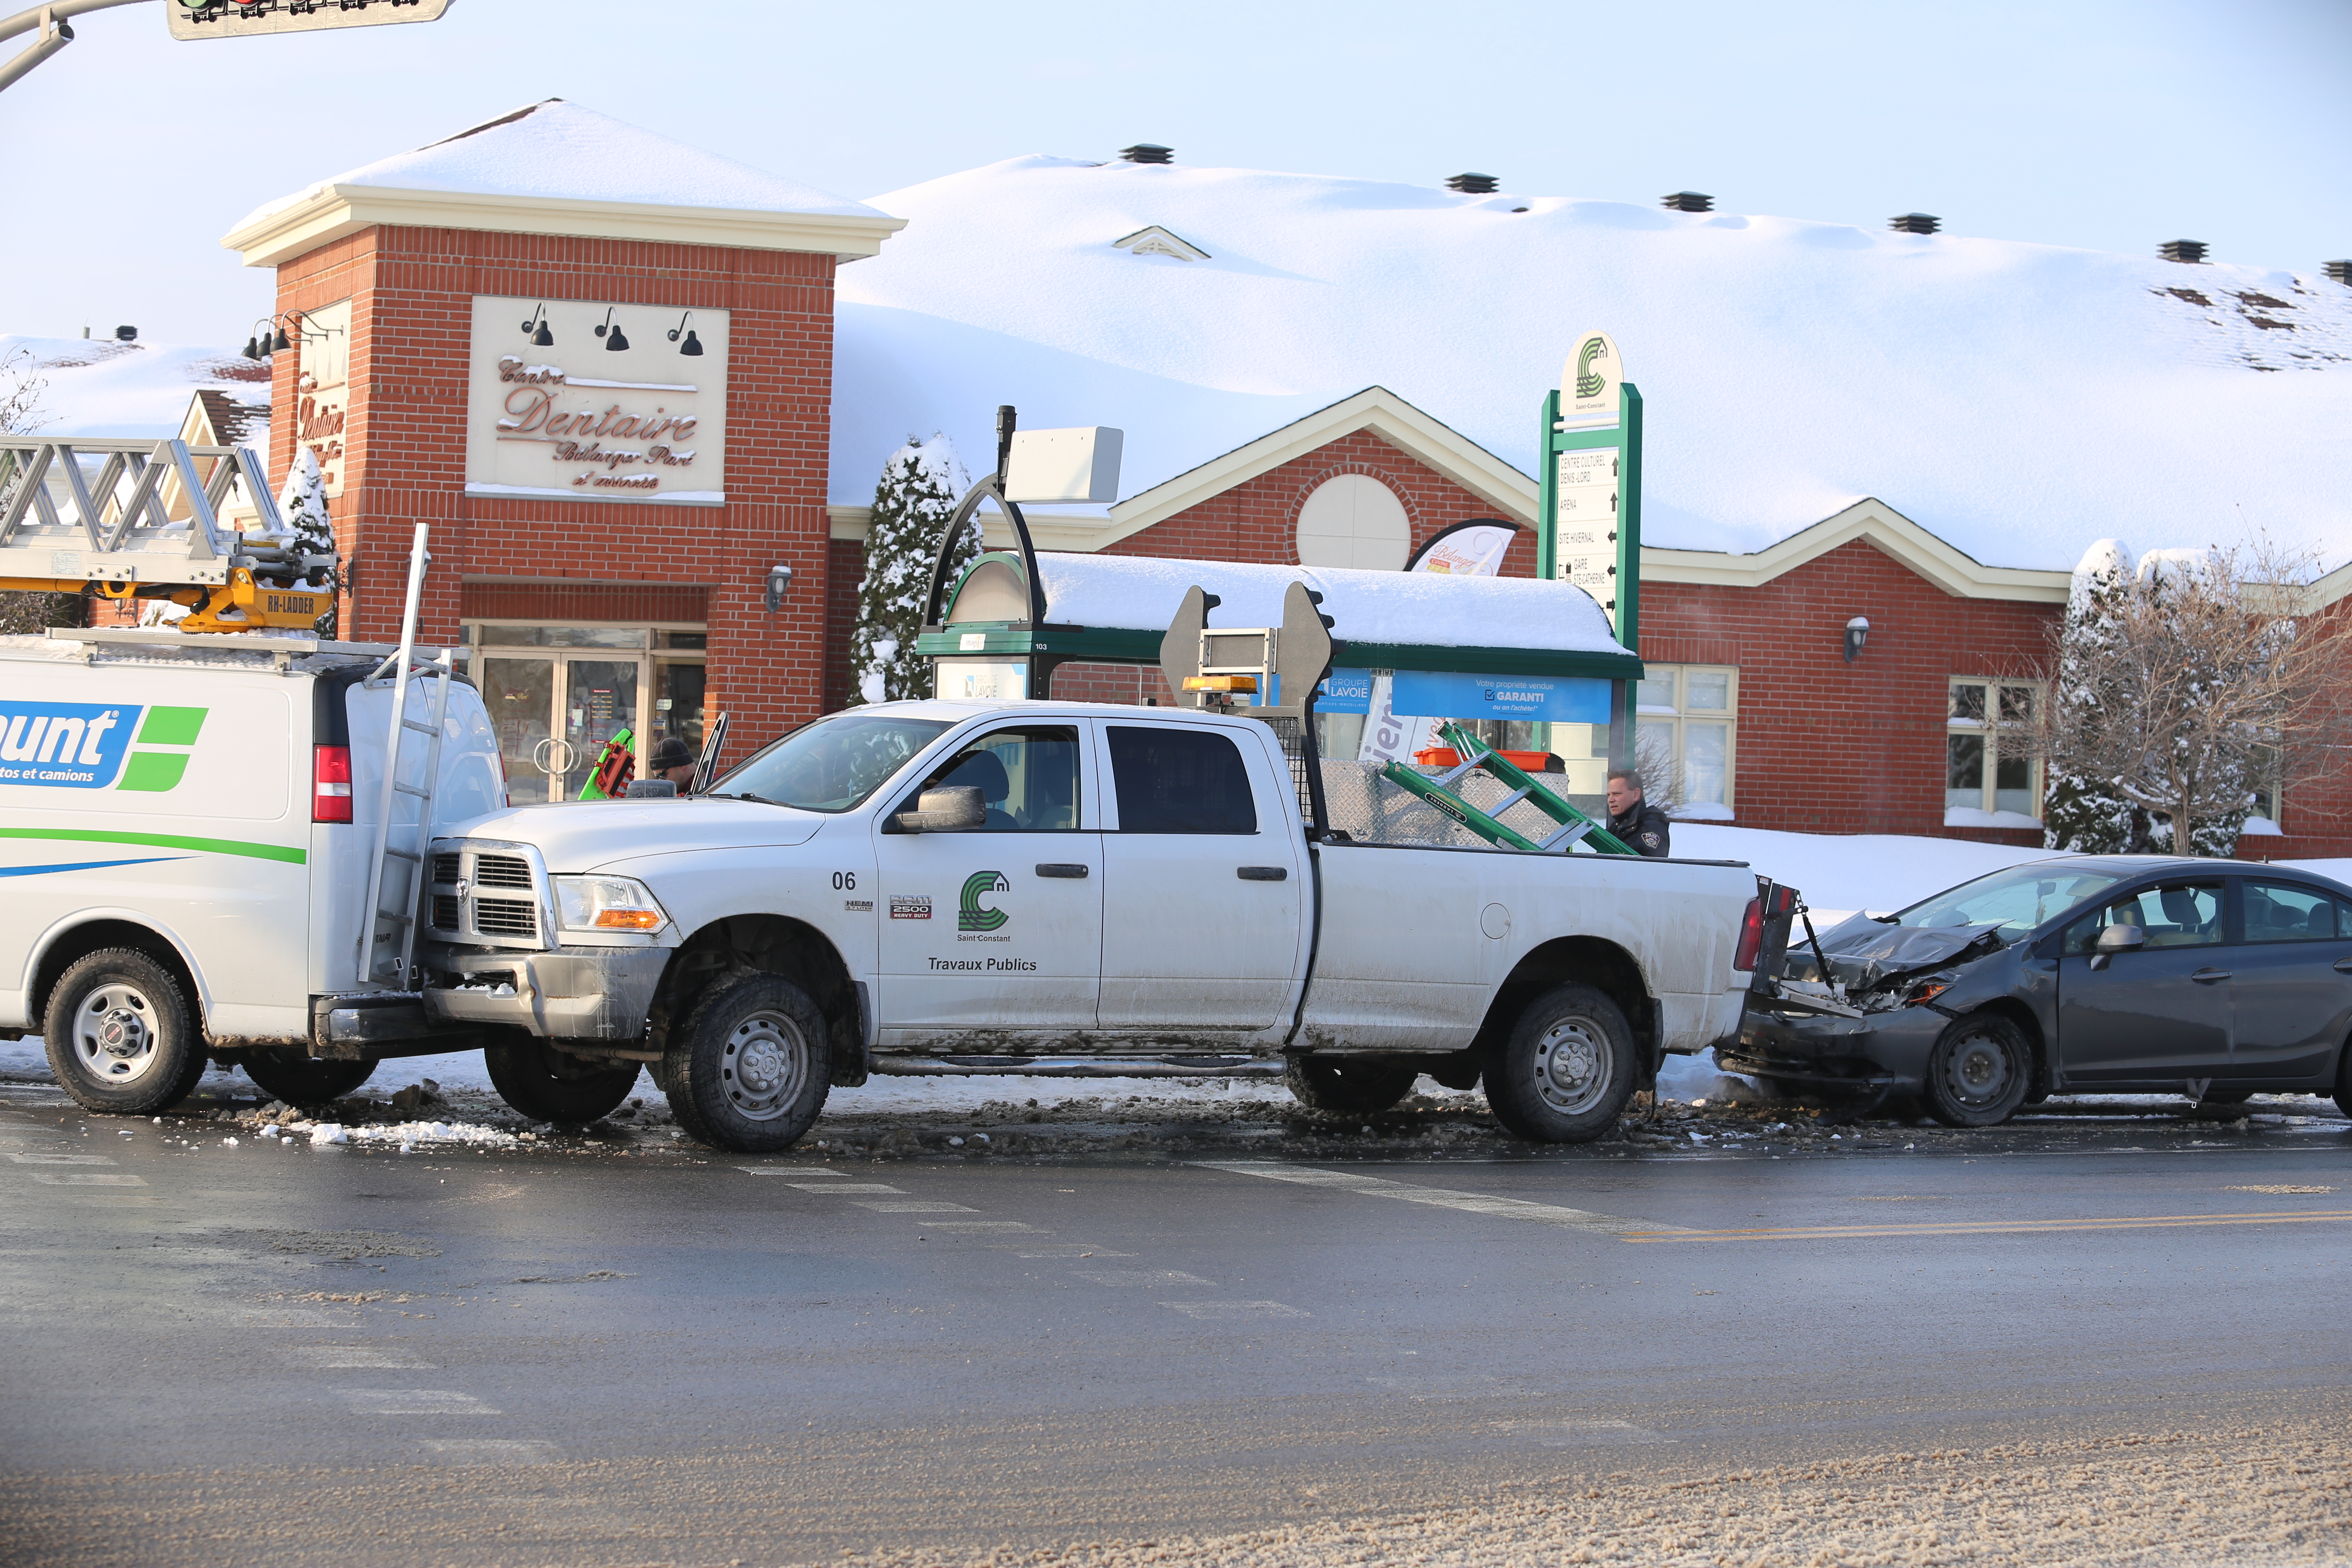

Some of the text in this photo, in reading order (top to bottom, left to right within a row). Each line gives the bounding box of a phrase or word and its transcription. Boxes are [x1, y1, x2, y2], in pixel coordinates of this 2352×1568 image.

[498, 358, 566, 385] Centre
[496, 386, 697, 441] Dentaire
[553, 440, 696, 470] Bélanger Paré
[1561, 455, 1605, 469] CENTRE CULTUREL
[573, 471, 596, 486] et
[1561, 472, 1575, 484] DENIS
[1560, 496, 1577, 511] ARÉNA
[1559, 532, 1594, 544] SITE HIVERNAL
[1430, 545, 1477, 570] Bélanger
[1574, 558, 1587, 570] GARE
[1574, 573, 1605, 585] STE-CATHERINE
[268, 595, 314, 614] RH-LADDER
[975, 675, 998, 684] GROUPE
[1331, 679, 1368, 687] GROUPE
[1496, 681, 1527, 689] propriété
[975, 685, 997, 698] LAVOIE
[1331, 686, 1368, 698] LAVOIE
[1497, 692, 1544, 702] GARANTI
[0, 710, 117, 765] unt
[23, 768, 37, 779] et
[39, 769, 95, 782] camions
[1430, 797, 1453, 813] LADDERS
[832, 871, 856, 890] 06
[890, 894, 932, 904] RAM
[928, 957, 1037, 971] Travaux Publics
